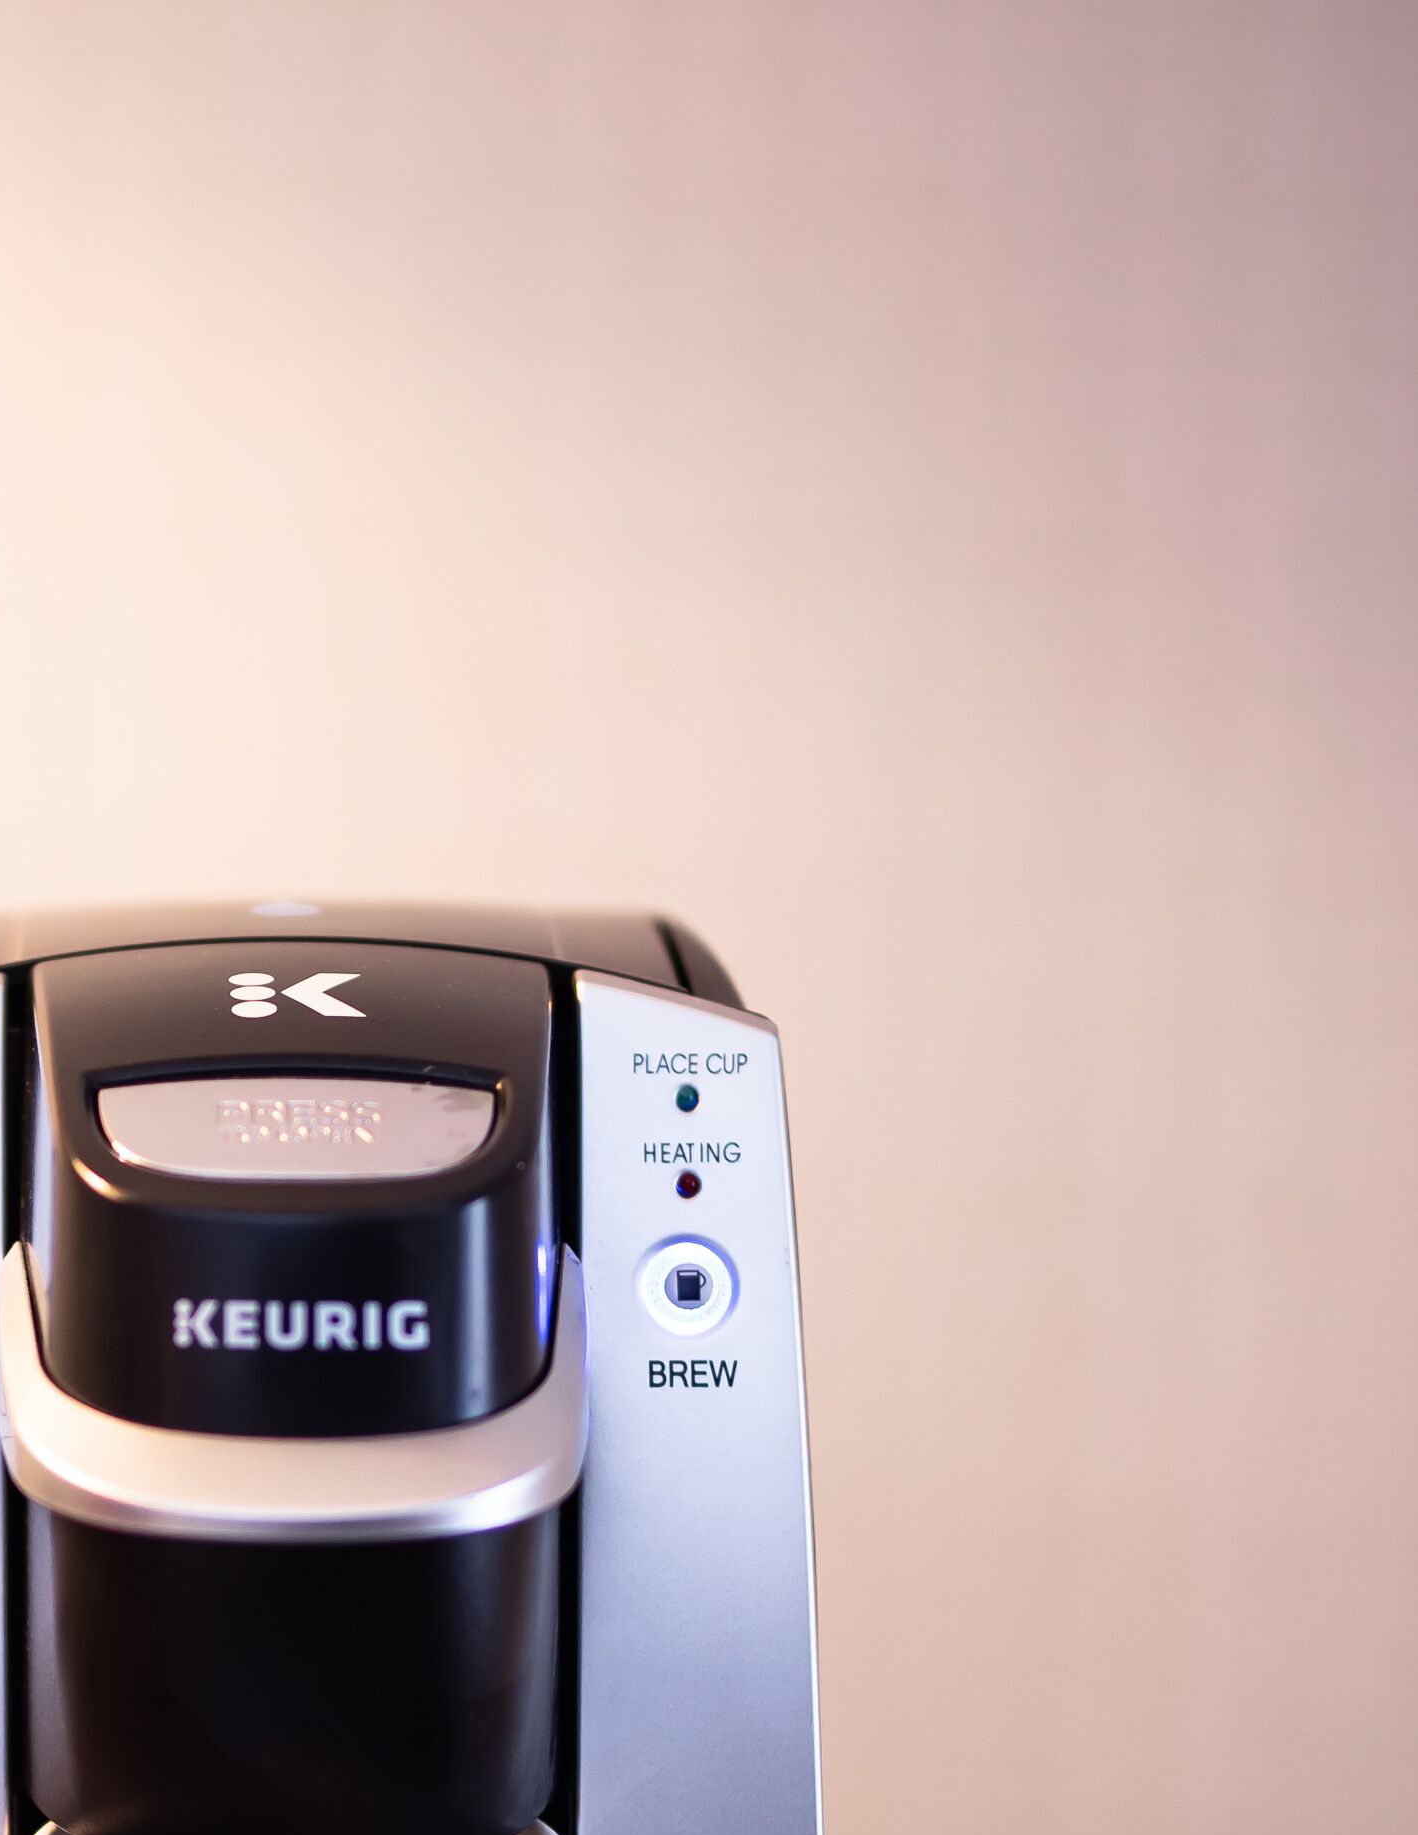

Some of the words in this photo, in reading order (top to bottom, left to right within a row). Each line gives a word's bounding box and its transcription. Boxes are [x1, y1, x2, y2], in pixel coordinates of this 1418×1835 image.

[632, 1053, 699, 1075] PLACE
[705, 1053, 749, 1075] CUP
[643, 1141, 742, 1164] HEATING
[173, 1298, 431, 1351] KEURIG
[647, 1359, 739, 1389] BREW
